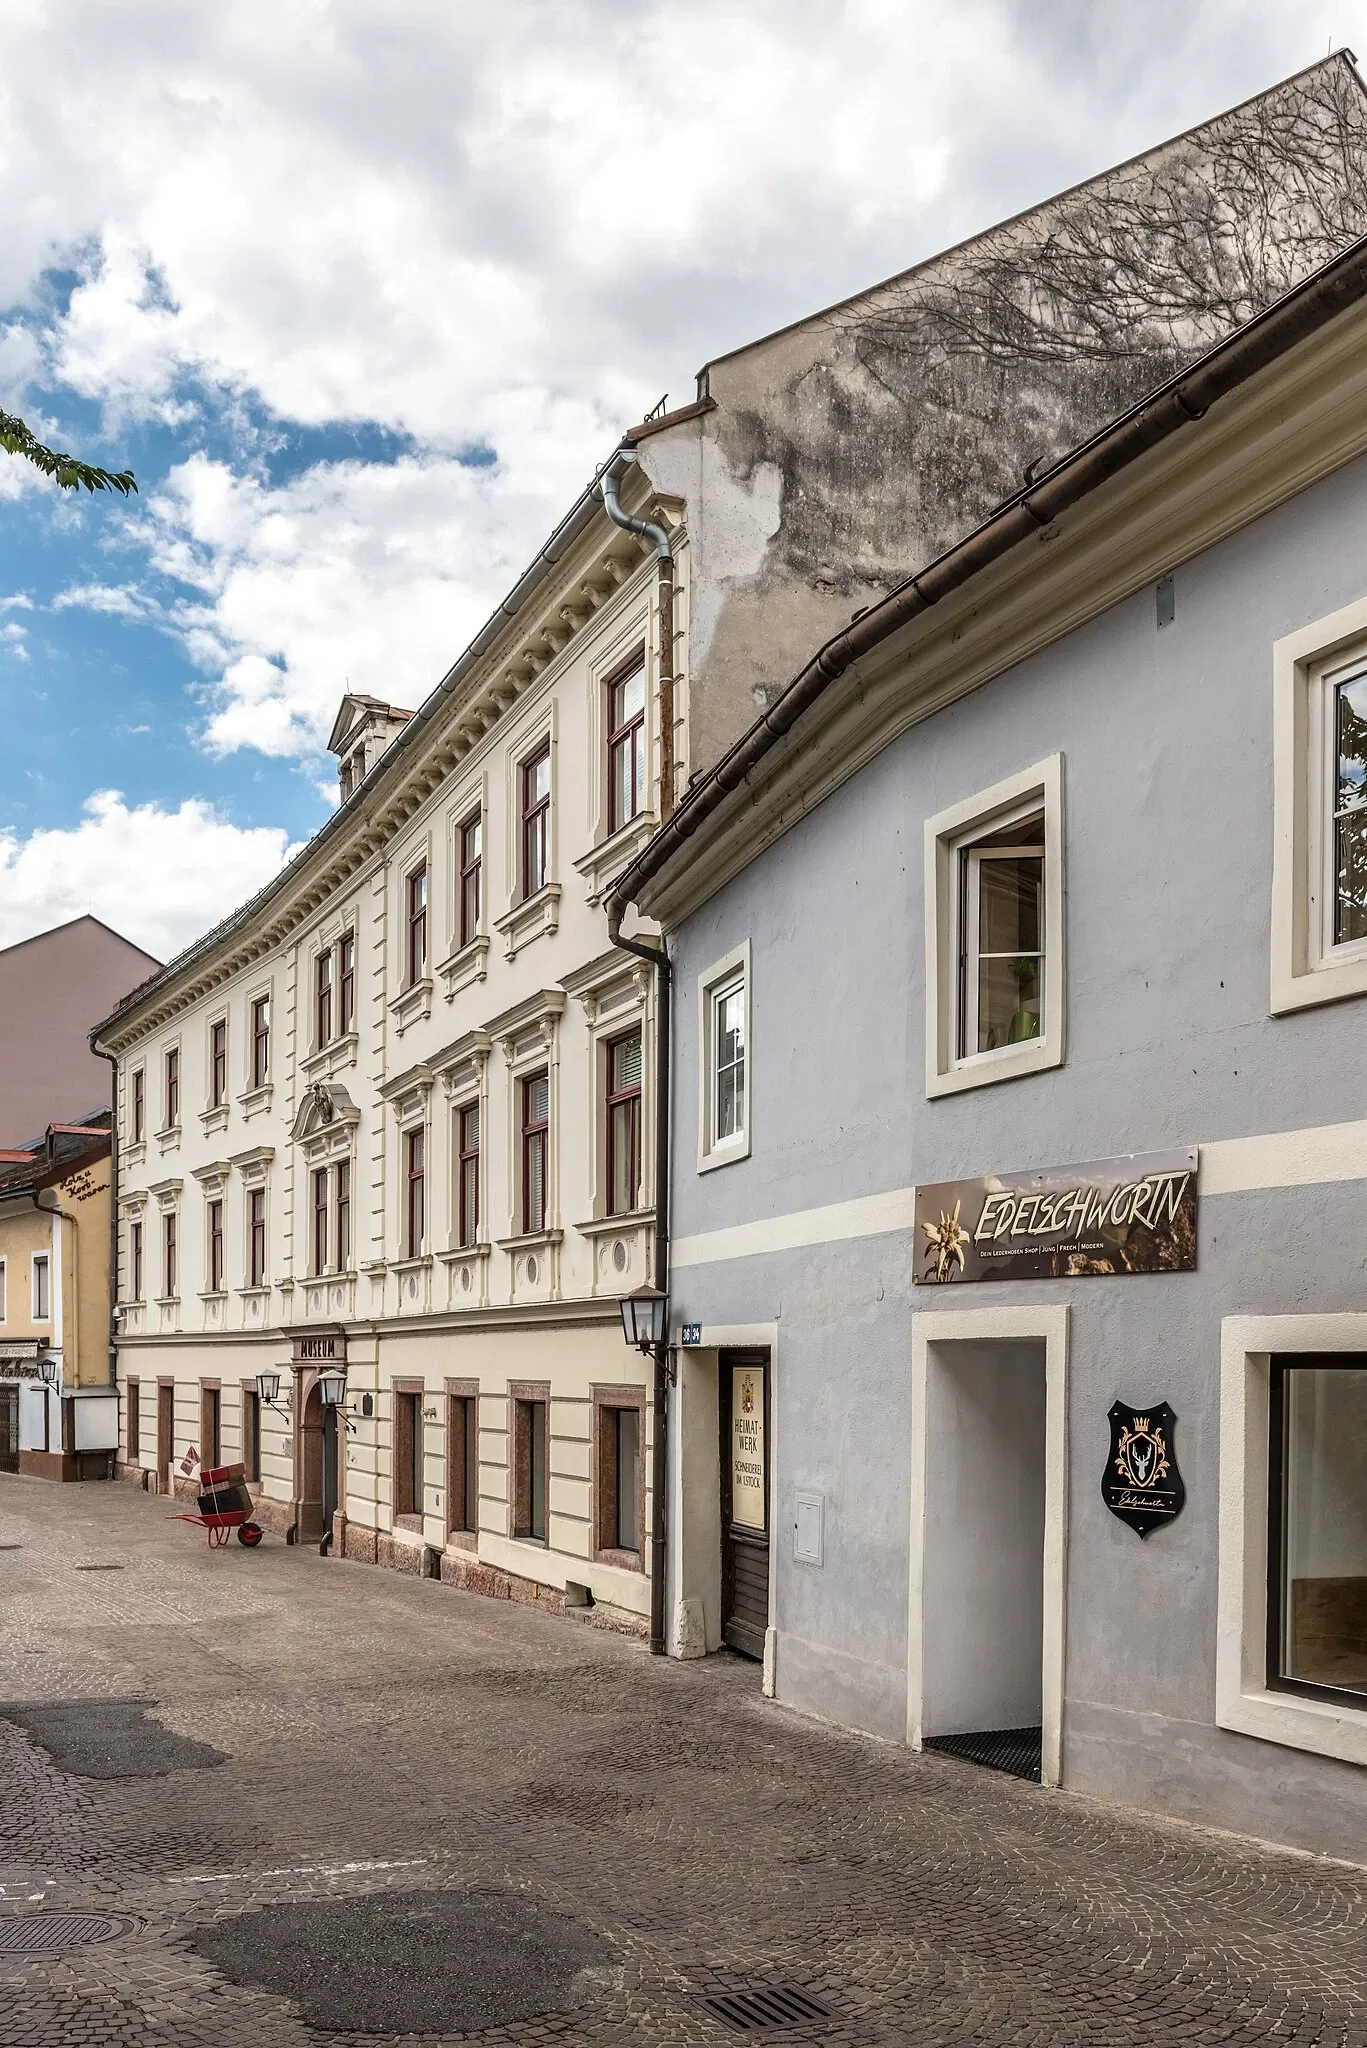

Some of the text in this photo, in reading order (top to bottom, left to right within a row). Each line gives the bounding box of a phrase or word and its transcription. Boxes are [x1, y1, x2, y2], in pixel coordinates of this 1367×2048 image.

[77, 1184, 110, 1201] waren
[683, 1328, 690, 1341] 36
[692, 1327, 699, 1340] 34
[301, 1339, 334, 1357] MUSEUM
[735, 1418, 762, 1435] HEIMAT-
[739, 1436, 757, 1454] WERK
[735, 1460, 761, 1475] SCHNEIDEREI
[736, 1474, 742, 1484] IM
